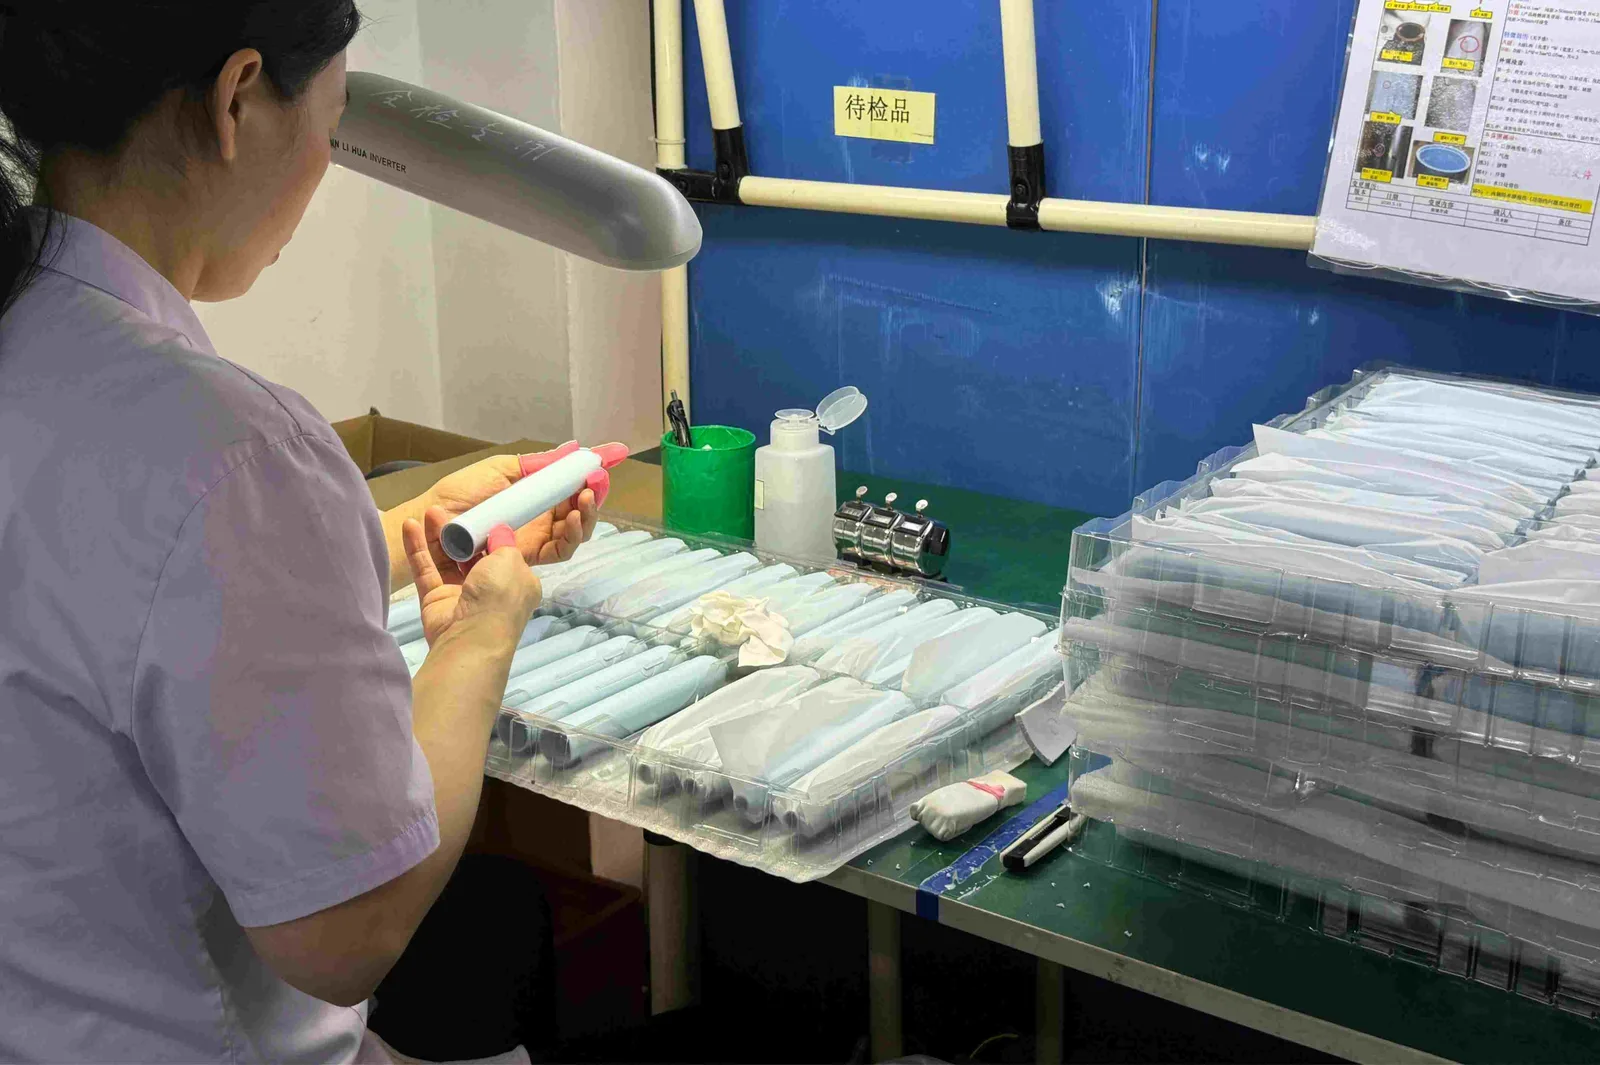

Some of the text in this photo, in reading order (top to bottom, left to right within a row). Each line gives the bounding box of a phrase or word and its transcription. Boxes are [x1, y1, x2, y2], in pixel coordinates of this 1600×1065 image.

[845, 94, 909, 123] 待检品
[342, 142, 349, 153] LI
[351, 145, 367, 159] HUA
[369, 152, 407, 174] INVERTER
